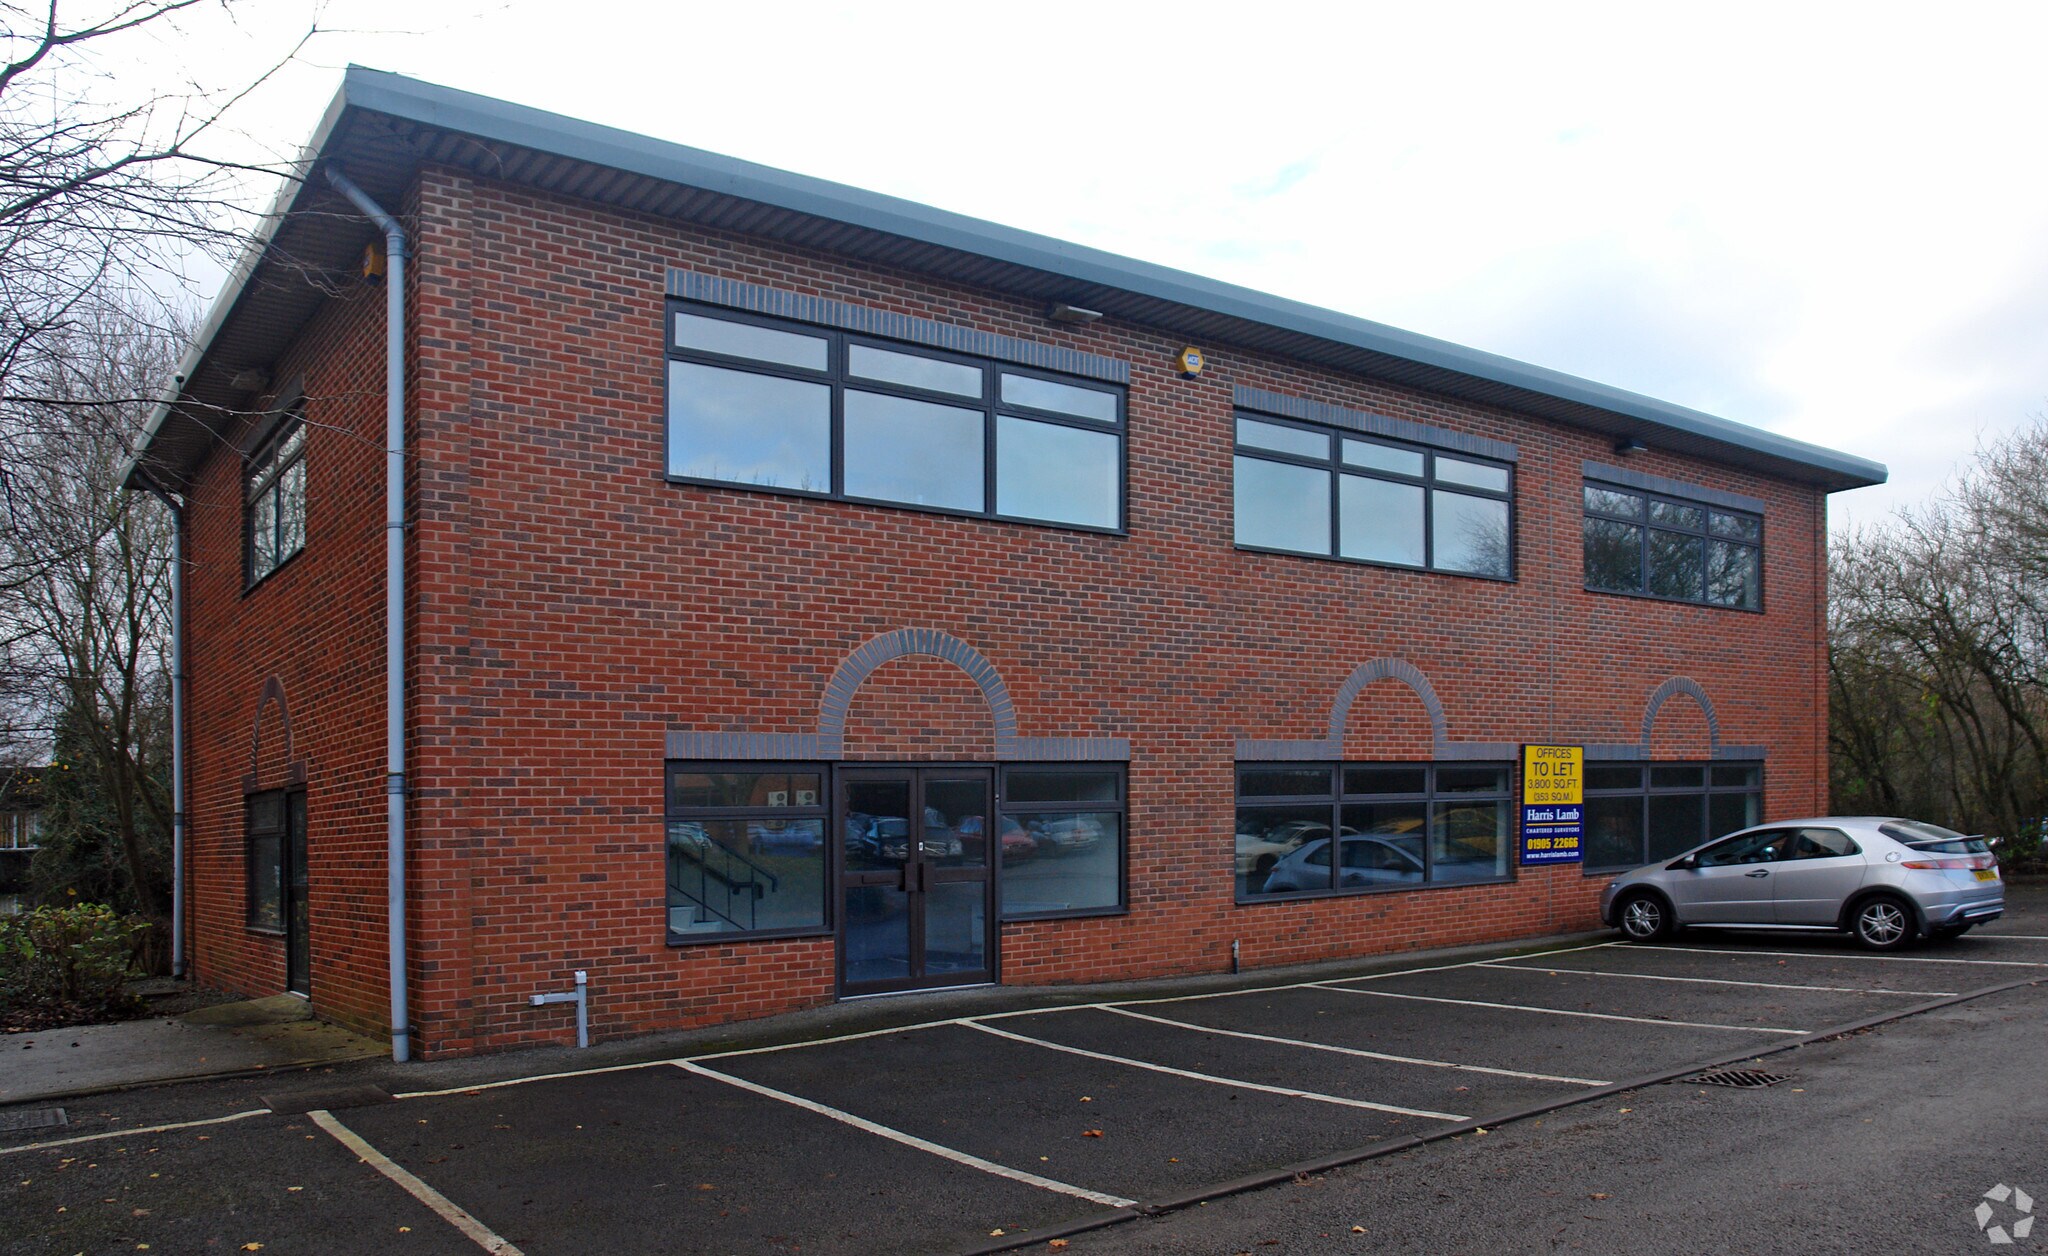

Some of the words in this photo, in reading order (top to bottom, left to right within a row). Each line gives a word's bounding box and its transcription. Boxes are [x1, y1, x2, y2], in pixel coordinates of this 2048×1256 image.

[1536, 748, 1572, 758] OFFICES
[1532, 762, 1548, 776] TO
[1552, 762, 1574, 776] LET
[1528, 779, 1550, 789] 3,800
[1534, 792, 1548, 802] (353
[1527, 809, 1554, 820] Harris
[1556, 808, 1580, 820] Lamb
[1527, 838, 1551, 850] 01905
